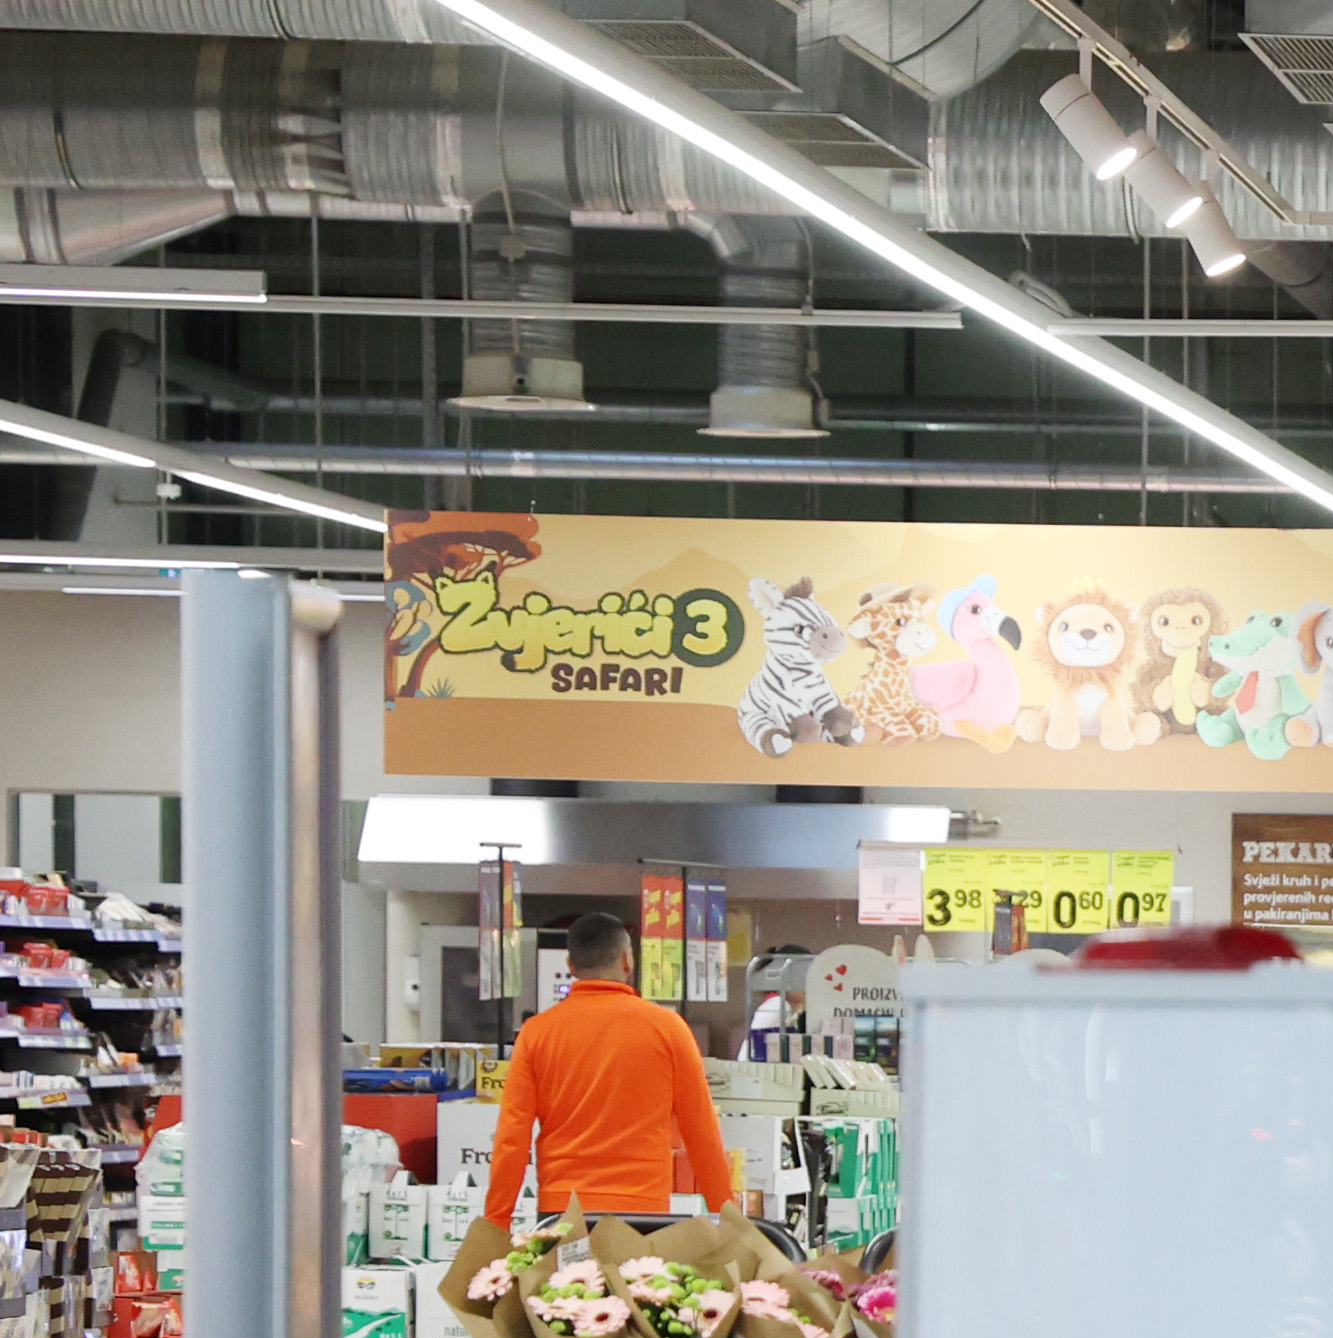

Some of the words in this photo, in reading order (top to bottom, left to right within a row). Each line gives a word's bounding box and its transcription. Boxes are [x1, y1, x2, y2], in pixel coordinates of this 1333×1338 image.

[683, 602, 729, 656] 3
[551, 662, 684, 696] SAFARI
[1244, 873, 1280, 893] Svježi
[1283, 874, 1311, 887] kruh
[1314, 875, 1318, 887] i
[926, 889, 953, 927] 3
[955, 889, 982, 909] 98
[1054, 891, 1077, 928] 0
[1079, 891, 1103, 910] 60
[1142, 893, 1167, 912] 97
[1243, 892, 1316, 906] provjerenih
[1244, 910, 1253, 919] u
[1255, 908, 1329, 923] pakiranjima
